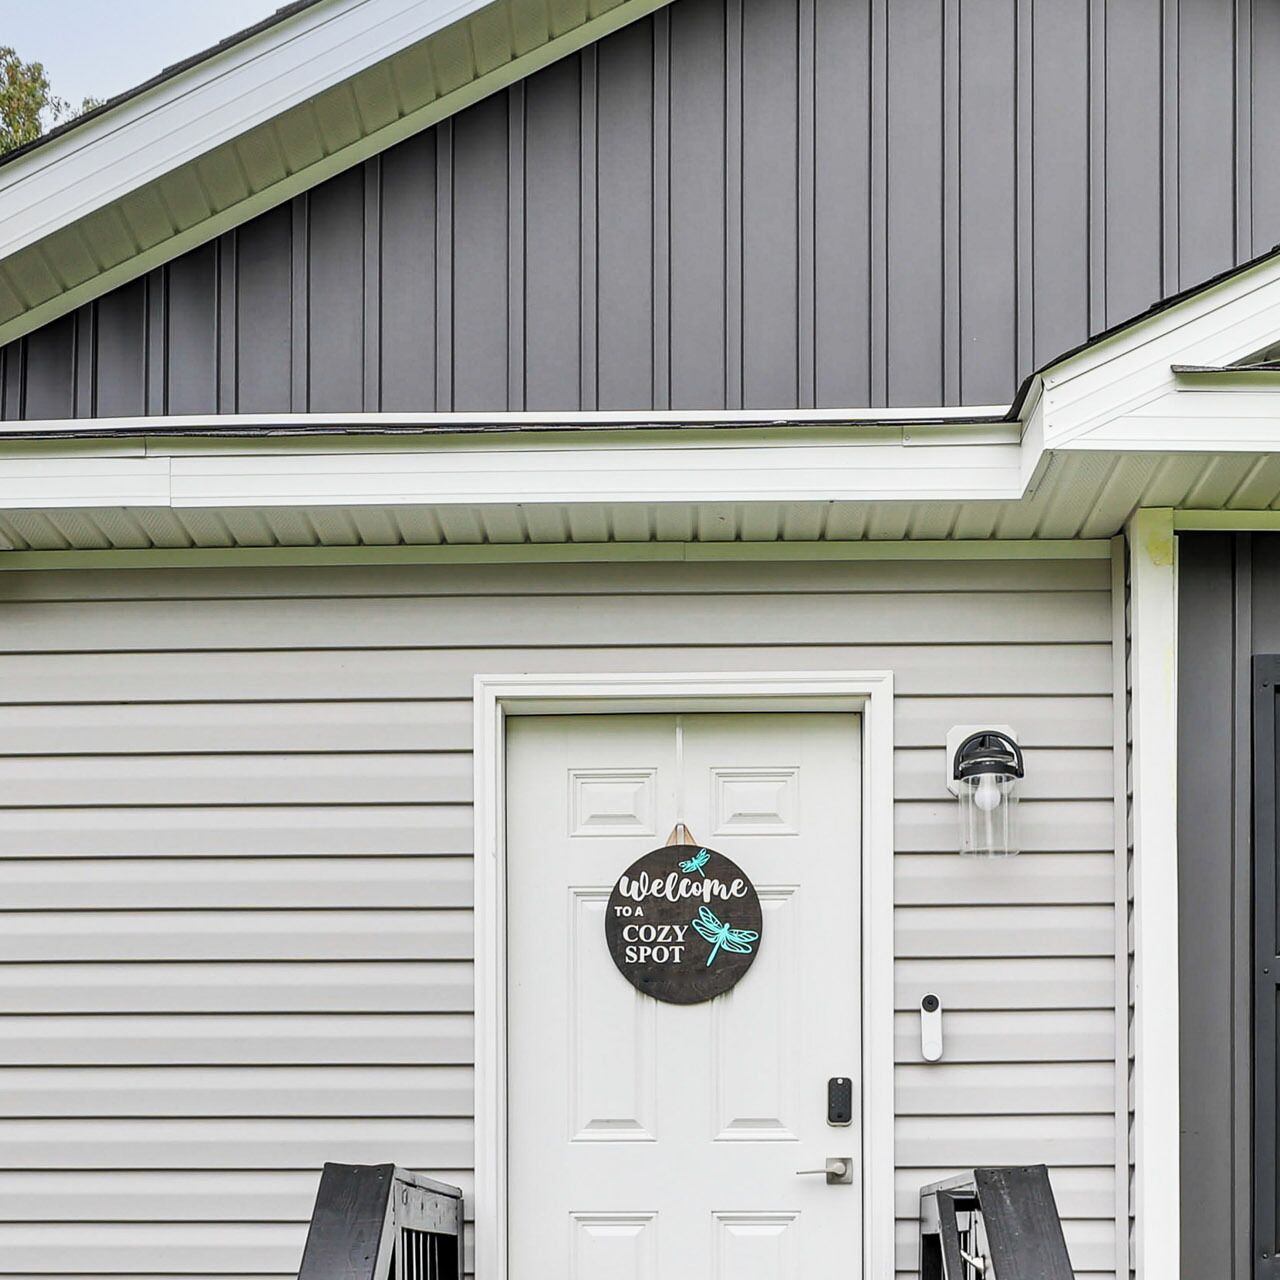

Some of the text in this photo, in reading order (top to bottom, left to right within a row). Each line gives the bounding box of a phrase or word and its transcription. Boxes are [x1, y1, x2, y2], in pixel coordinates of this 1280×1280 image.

[619, 871, 748, 903] Welcome
[614, 906, 644, 917] TO A
[622, 925, 688, 942] COZY
[625, 946, 685, 963] SPOT
